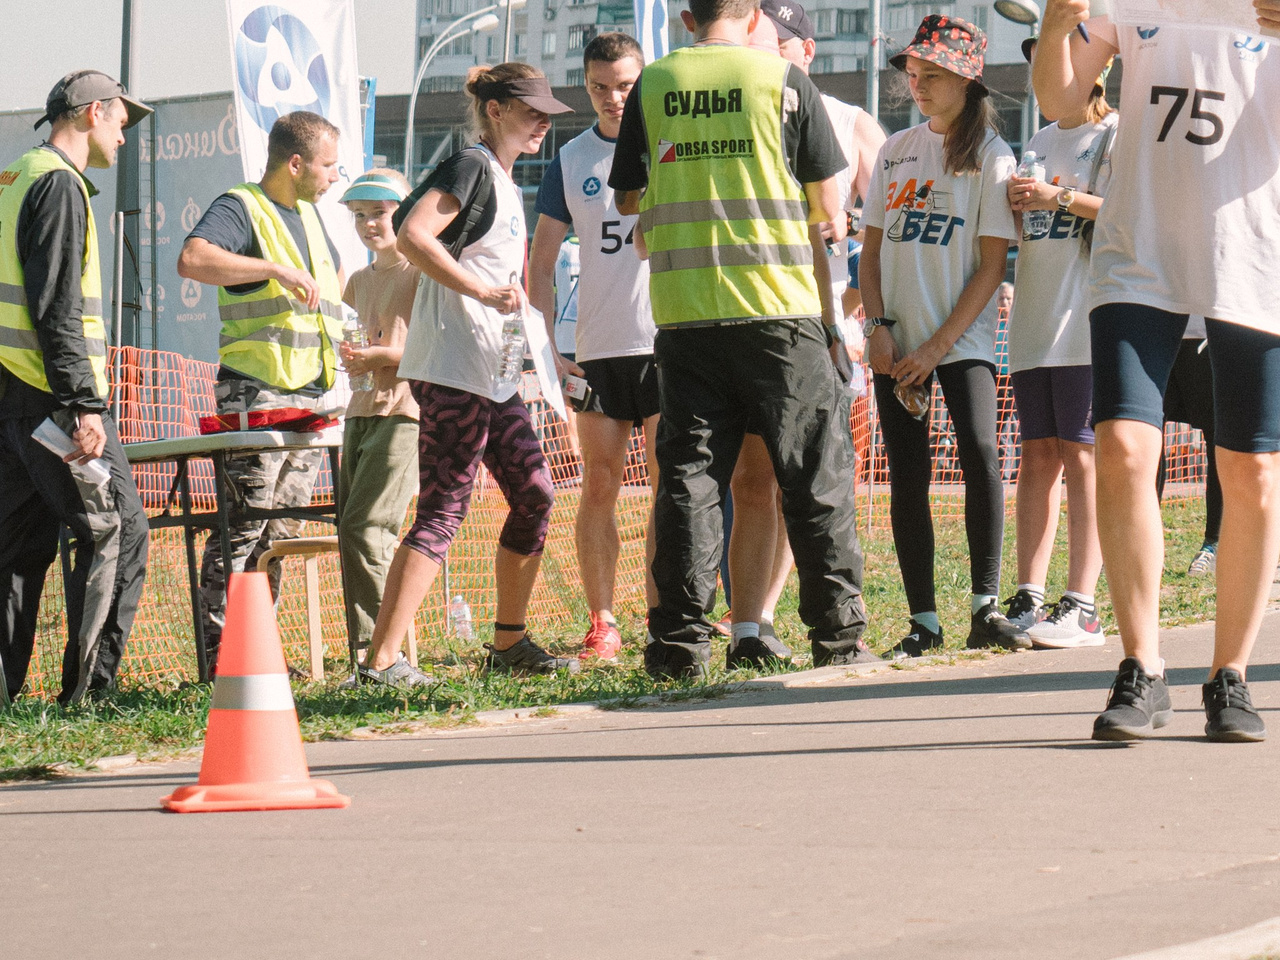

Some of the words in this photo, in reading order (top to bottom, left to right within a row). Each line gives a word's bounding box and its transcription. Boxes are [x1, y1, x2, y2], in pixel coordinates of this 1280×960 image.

[663, 87, 743, 119] СУДЬЯ
[1150, 85, 1226, 146] 75
[675, 140, 710, 157] ORSA
[711, 138, 755, 155] SPORT
[901, 211, 966, 246] БЕГ
